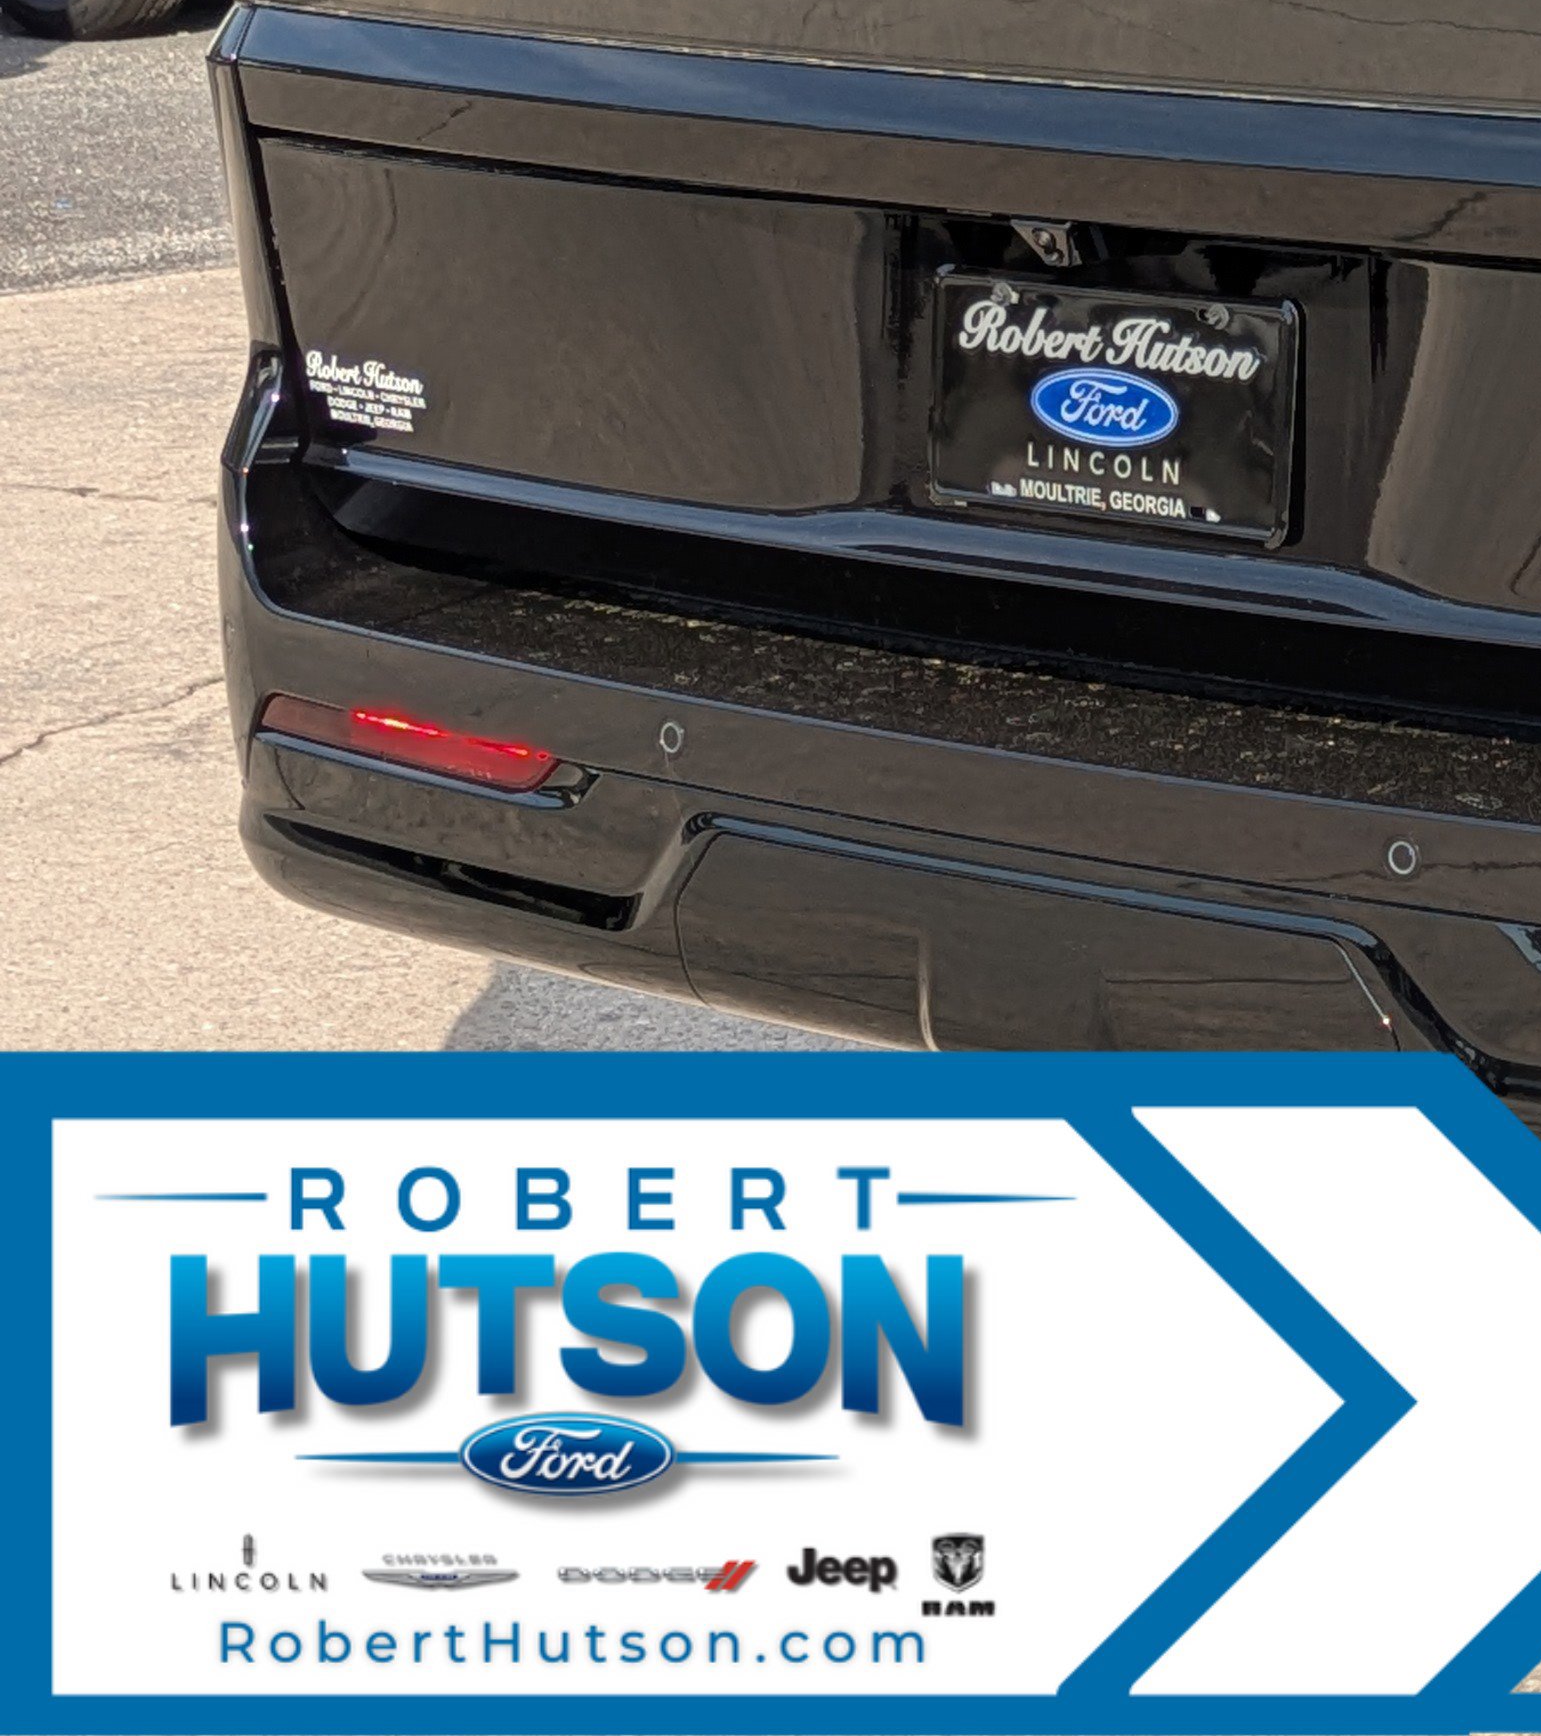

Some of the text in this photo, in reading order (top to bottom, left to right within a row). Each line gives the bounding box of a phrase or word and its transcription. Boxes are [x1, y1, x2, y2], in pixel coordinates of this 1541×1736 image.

[957, 299, 1261, 381] Robert Hutson
[305, 350, 424, 395] Robert Hutson
[1059, 378, 1150, 433] Ford
[1026, 441, 1181, 486] LINCOLN
[1019, 478, 1107, 512] MOULTRIE,
[1109, 490, 1187, 520] GEORGIA
